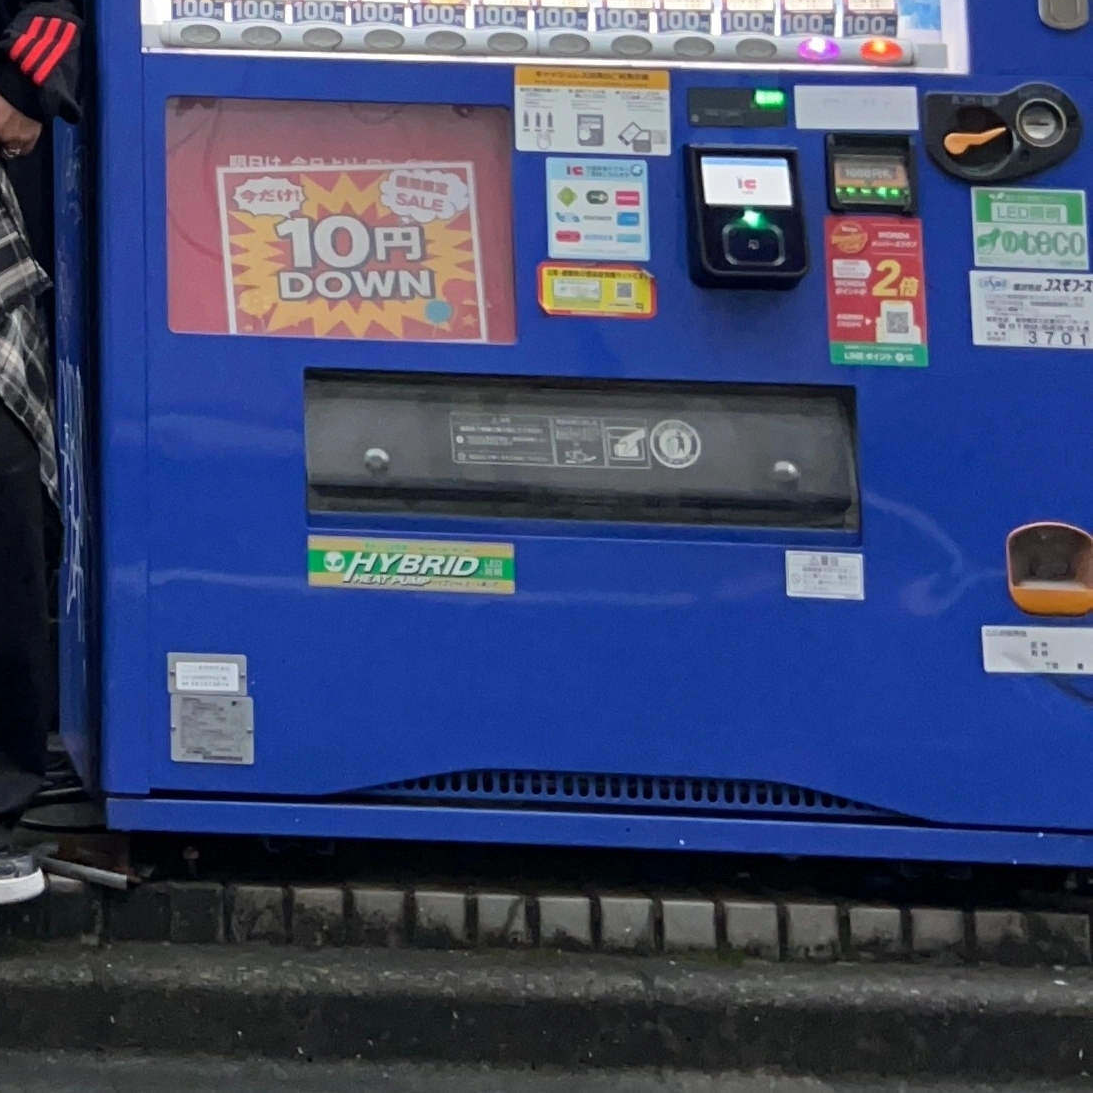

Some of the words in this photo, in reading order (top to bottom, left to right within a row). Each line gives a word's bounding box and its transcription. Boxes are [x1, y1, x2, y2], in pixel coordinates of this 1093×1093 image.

[240, 188, 301, 204] 今だけ!
[395, 192, 444, 213] SALE
[275, 214, 423, 269] 10円
[278, 270, 436, 301] DOWN
[1028, 330, 1086, 346] 3701
[343, 552, 480, 583] HYBRID
[355, 573, 391, 585] HEAT
[392, 575, 431, 587] PUMP
